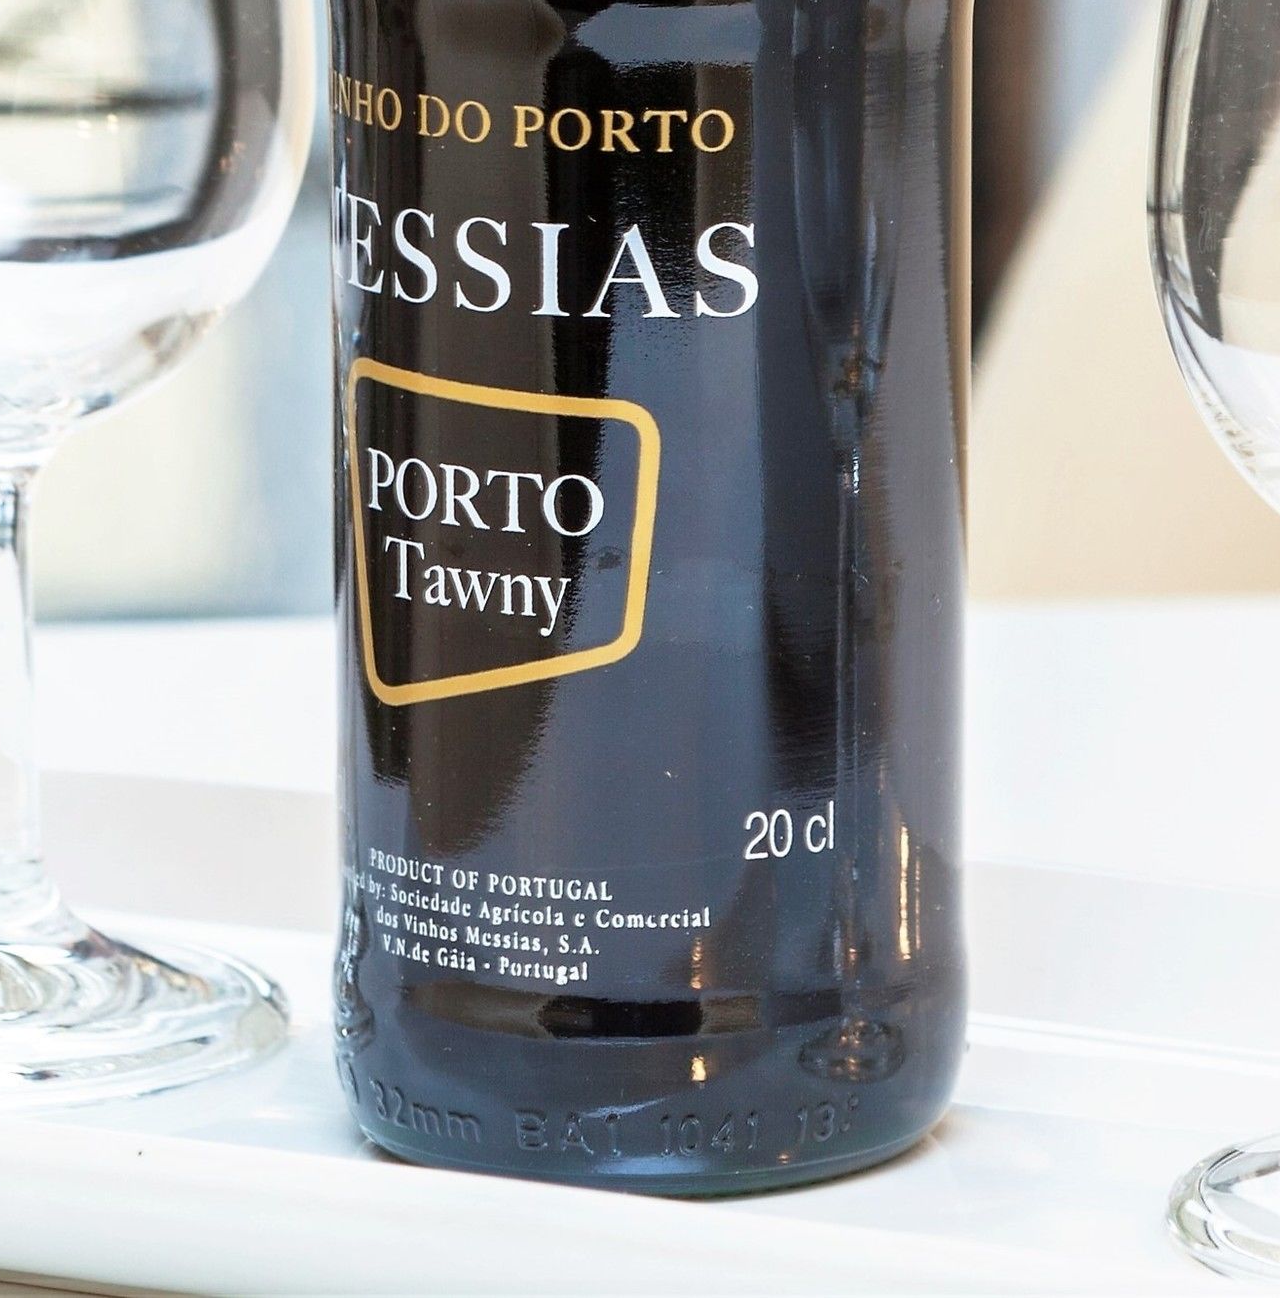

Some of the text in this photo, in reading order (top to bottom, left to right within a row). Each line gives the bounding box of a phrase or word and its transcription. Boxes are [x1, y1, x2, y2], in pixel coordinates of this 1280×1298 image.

[418, 93, 492, 144] DO
[512, 104, 737, 154] PORTO
[366, 447, 605, 538] PORTO
[384, 535, 572, 637] Tawny
[745, 800, 835, 860] 20 cl
[368, 873, 386, 901] by:
[391, 883, 472, 918] Sociedade
[596, 906, 711, 929] Comercial
[370, 847, 614, 902] PRODUCT OF PORTUGAL
[377, 905, 601, 957] dos Vinhos Messias, S.A.
[499, 955, 589, 986] Portugal
